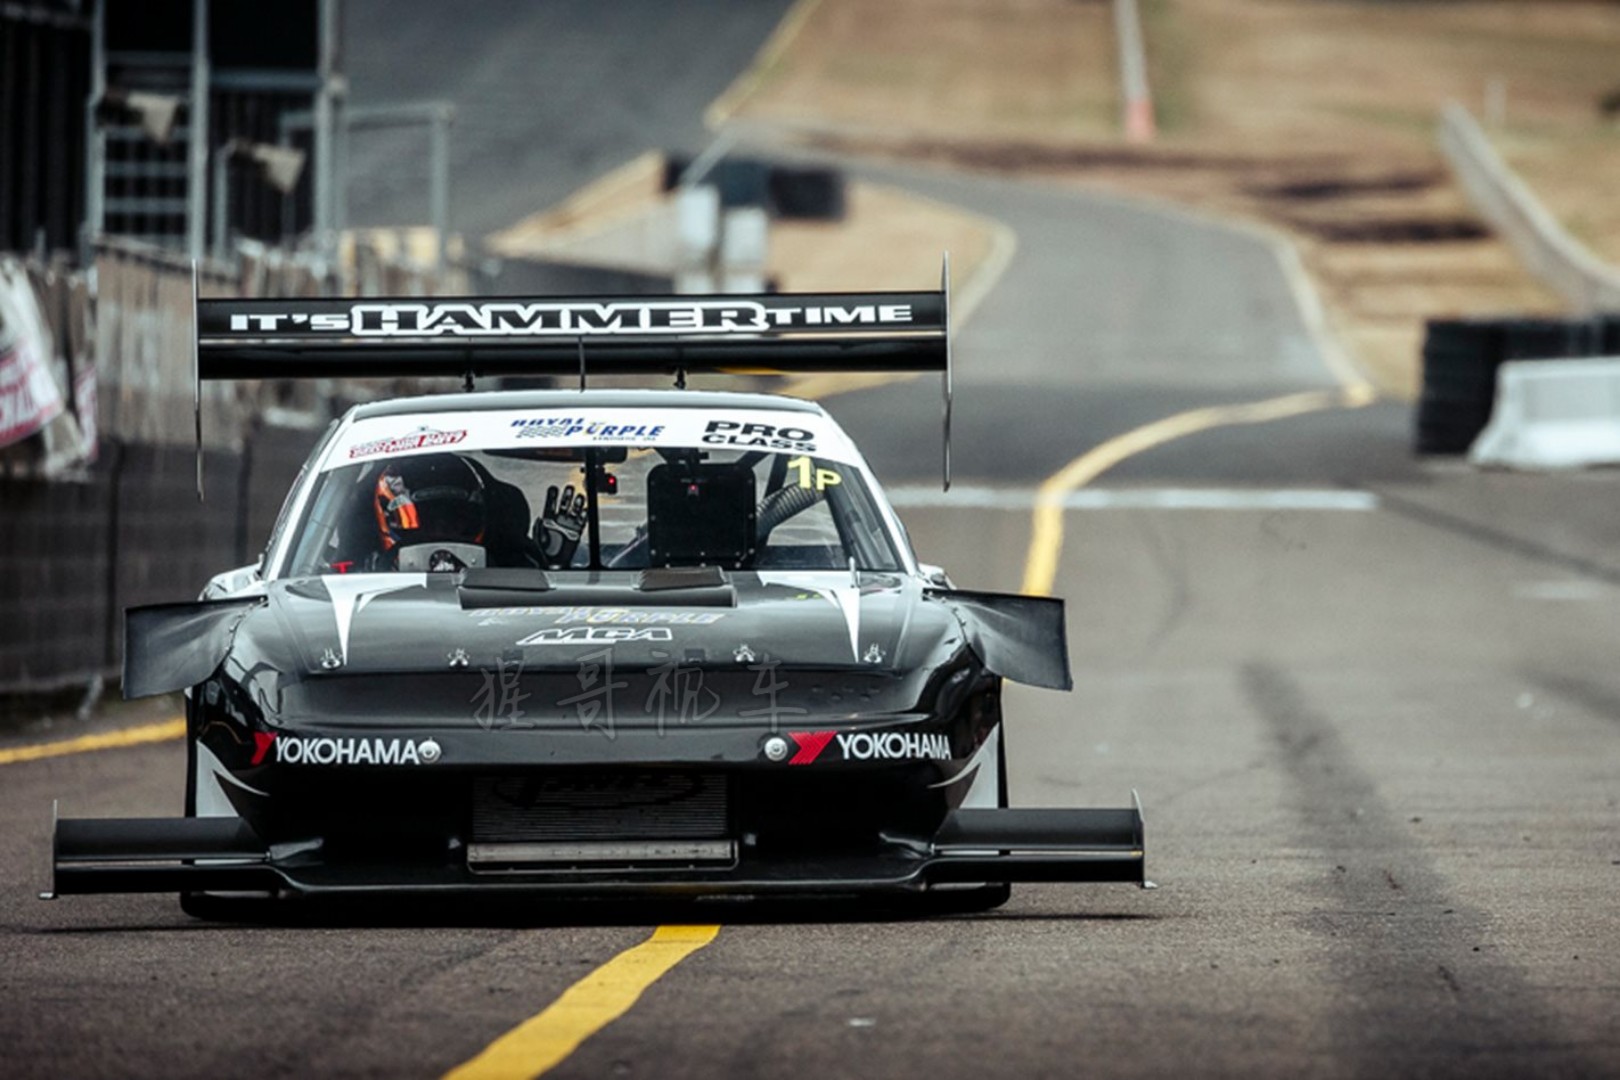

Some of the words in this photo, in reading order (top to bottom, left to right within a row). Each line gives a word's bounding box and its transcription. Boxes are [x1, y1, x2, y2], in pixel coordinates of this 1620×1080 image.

[230, 313, 350, 331] IT'S
[350, 301, 770, 336] HAMMER
[765, 305, 913, 325] TIME
[564, 423, 666, 436] PURPLE
[704, 420, 815, 442] PRO
[701, 434, 817, 452] CLASS
[275, 736, 420, 765] YOKOHAMA
[836, 732, 952, 761] YOKOHAMA
